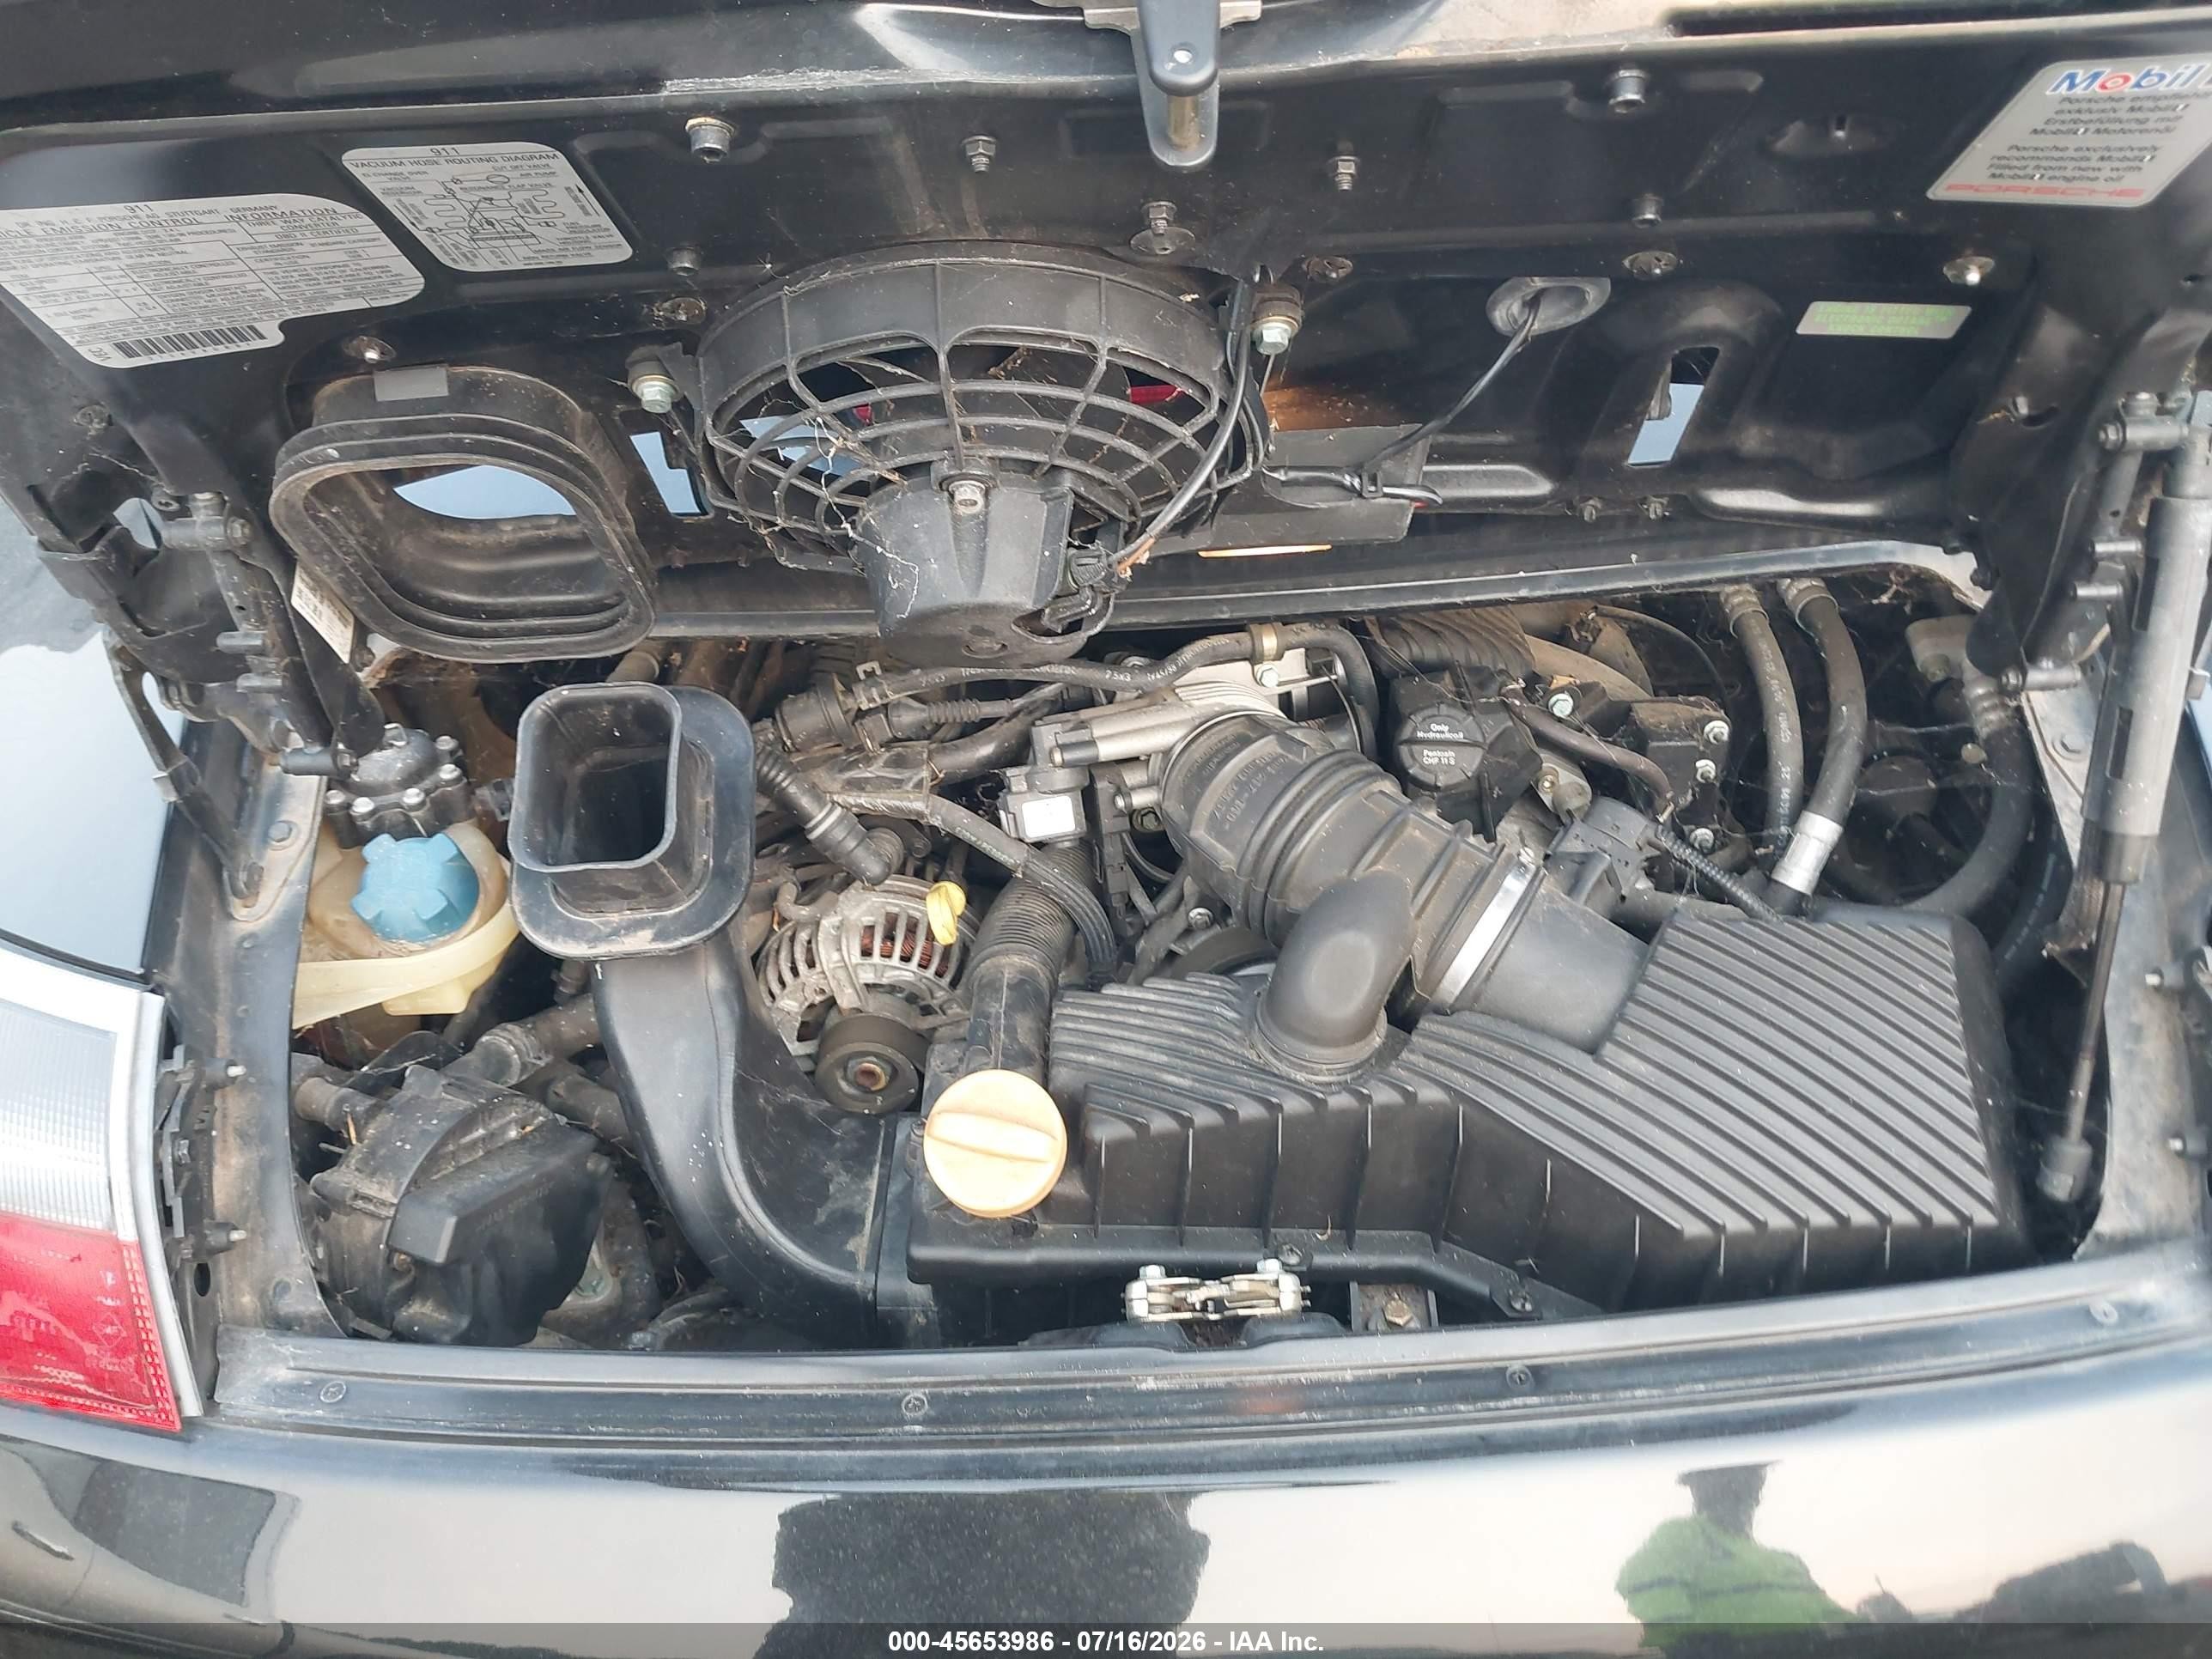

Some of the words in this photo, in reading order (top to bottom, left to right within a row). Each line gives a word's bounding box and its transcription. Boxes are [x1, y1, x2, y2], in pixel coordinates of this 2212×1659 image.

[2047, 64, 2208, 94] Mobil
[430, 147, 460, 155] 911
[2007, 144, 2070, 153] Porsche
[2073, 144, 2162, 153] exclusively
[349, 160, 407, 168] VACUUM
[408, 158, 444, 167] HOSE
[444, 156, 497, 166] ROUTING
[501, 153, 561, 162] DIAGRAM
[2109, 164, 2143, 173] with
[2047, 174, 2100, 183] engine
[2103, 174, 2126, 183] oil
[1945, 184, 2144, 198] PORSCHE
[124, 204, 154, 214] 911
[165, 208, 220, 217] STUTTGART
[41, 222, 122, 234] EMISSION
[129, 216, 201, 229] CONTROL
[224, 206, 337, 222] INFORMATION
[247, 218, 279, 228] THREE
[308, 213, 364, 222] CATALYTIC
[281, 221, 340, 231] CONVERTER
[309, 228, 359, 237] CERTIFIED
[1430, 723, 1449, 732] Only
